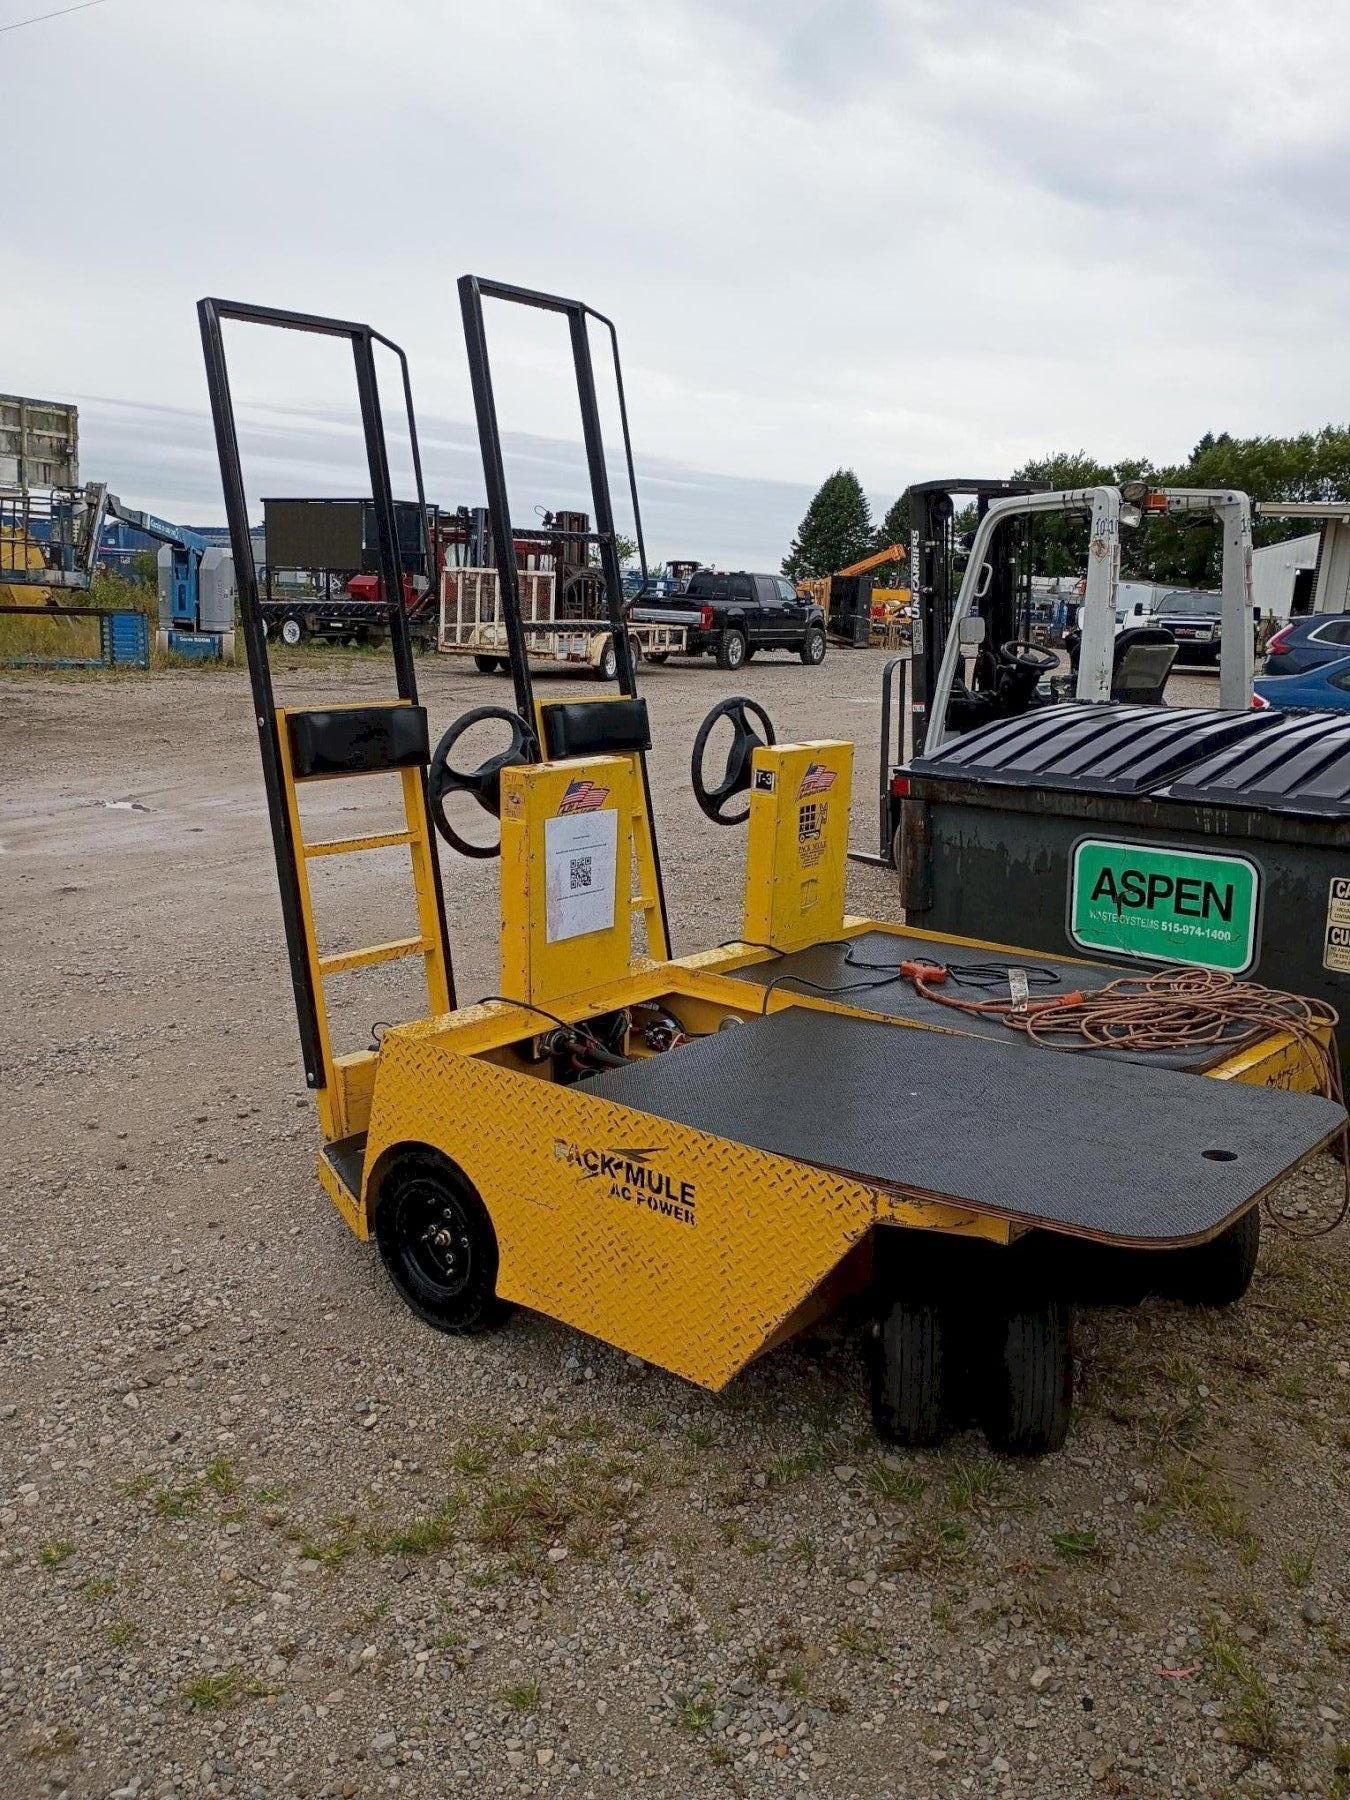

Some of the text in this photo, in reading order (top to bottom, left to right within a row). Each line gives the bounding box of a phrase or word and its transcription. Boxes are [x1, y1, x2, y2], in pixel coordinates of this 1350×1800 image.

[757, 771, 773, 785] T-3
[1090, 867, 1235, 923] ASPEN
[1161, 921, 1232, 941] 515-974-1400
[609, 1183, 697, 1227] AC POWER
